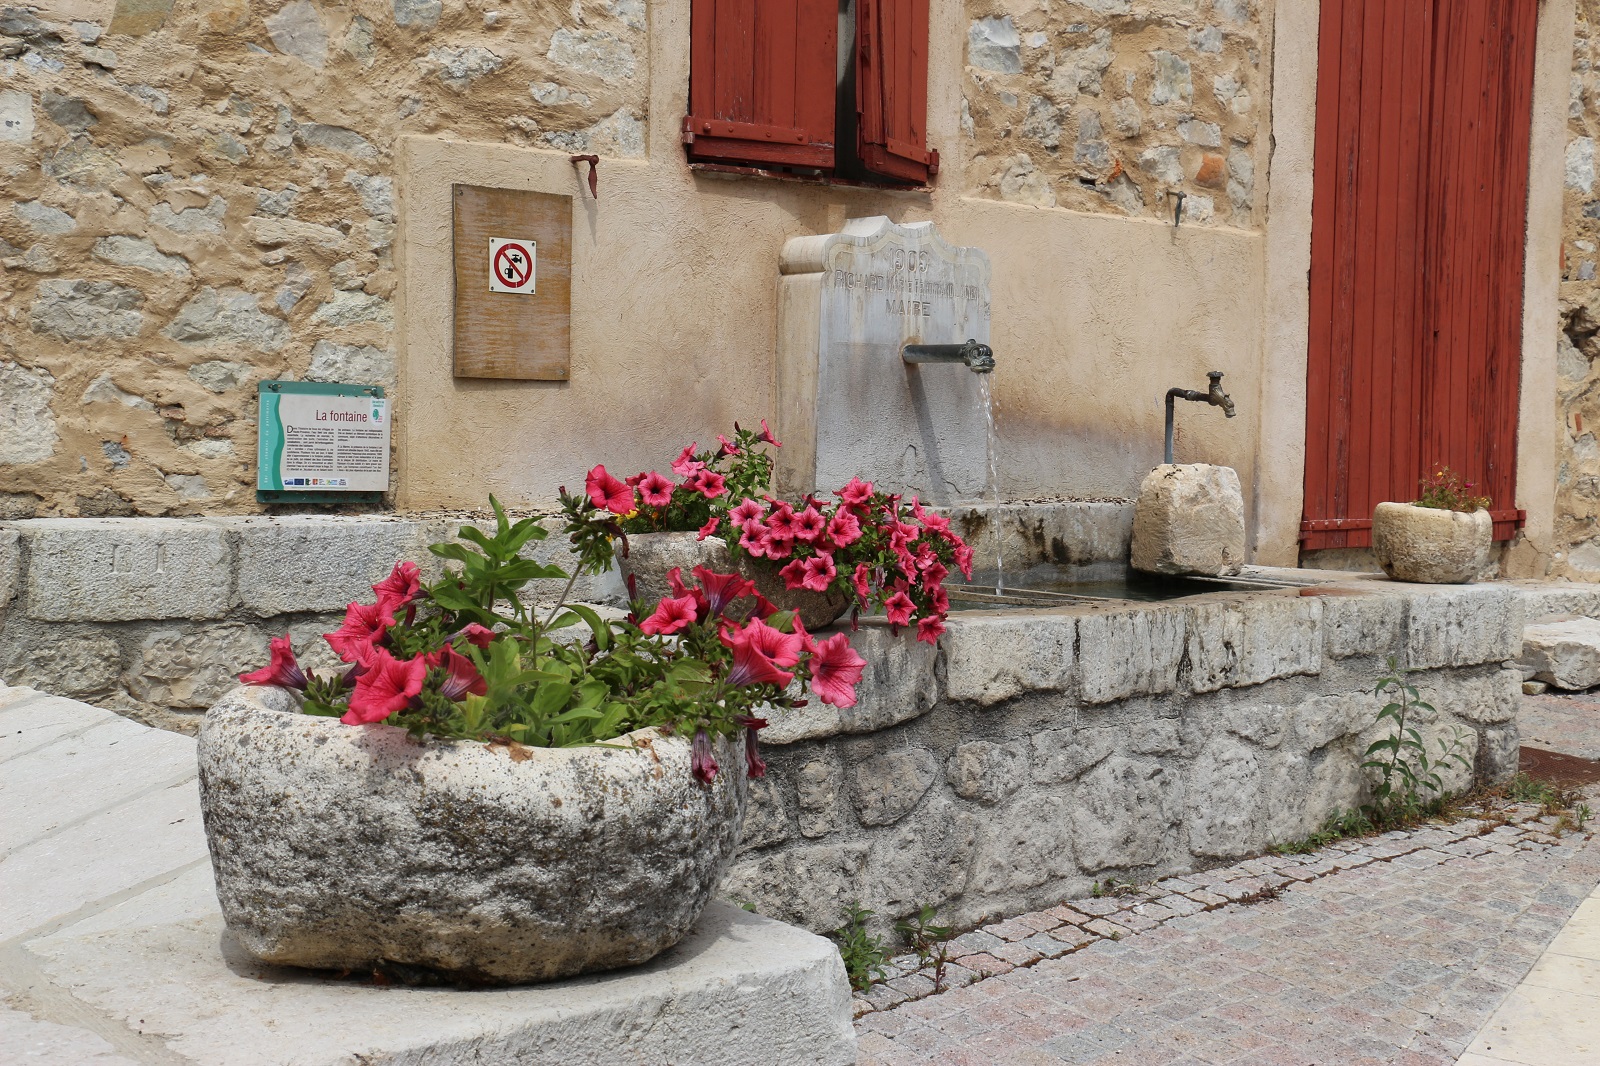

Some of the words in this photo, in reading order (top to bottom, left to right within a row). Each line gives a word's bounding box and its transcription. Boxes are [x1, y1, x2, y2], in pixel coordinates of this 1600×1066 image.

[834, 270, 884, 291] RICHARD
[885, 299, 931, 317] MAIRE
[315, 409, 327, 421] La
[329, 410, 368, 423] fontaine
